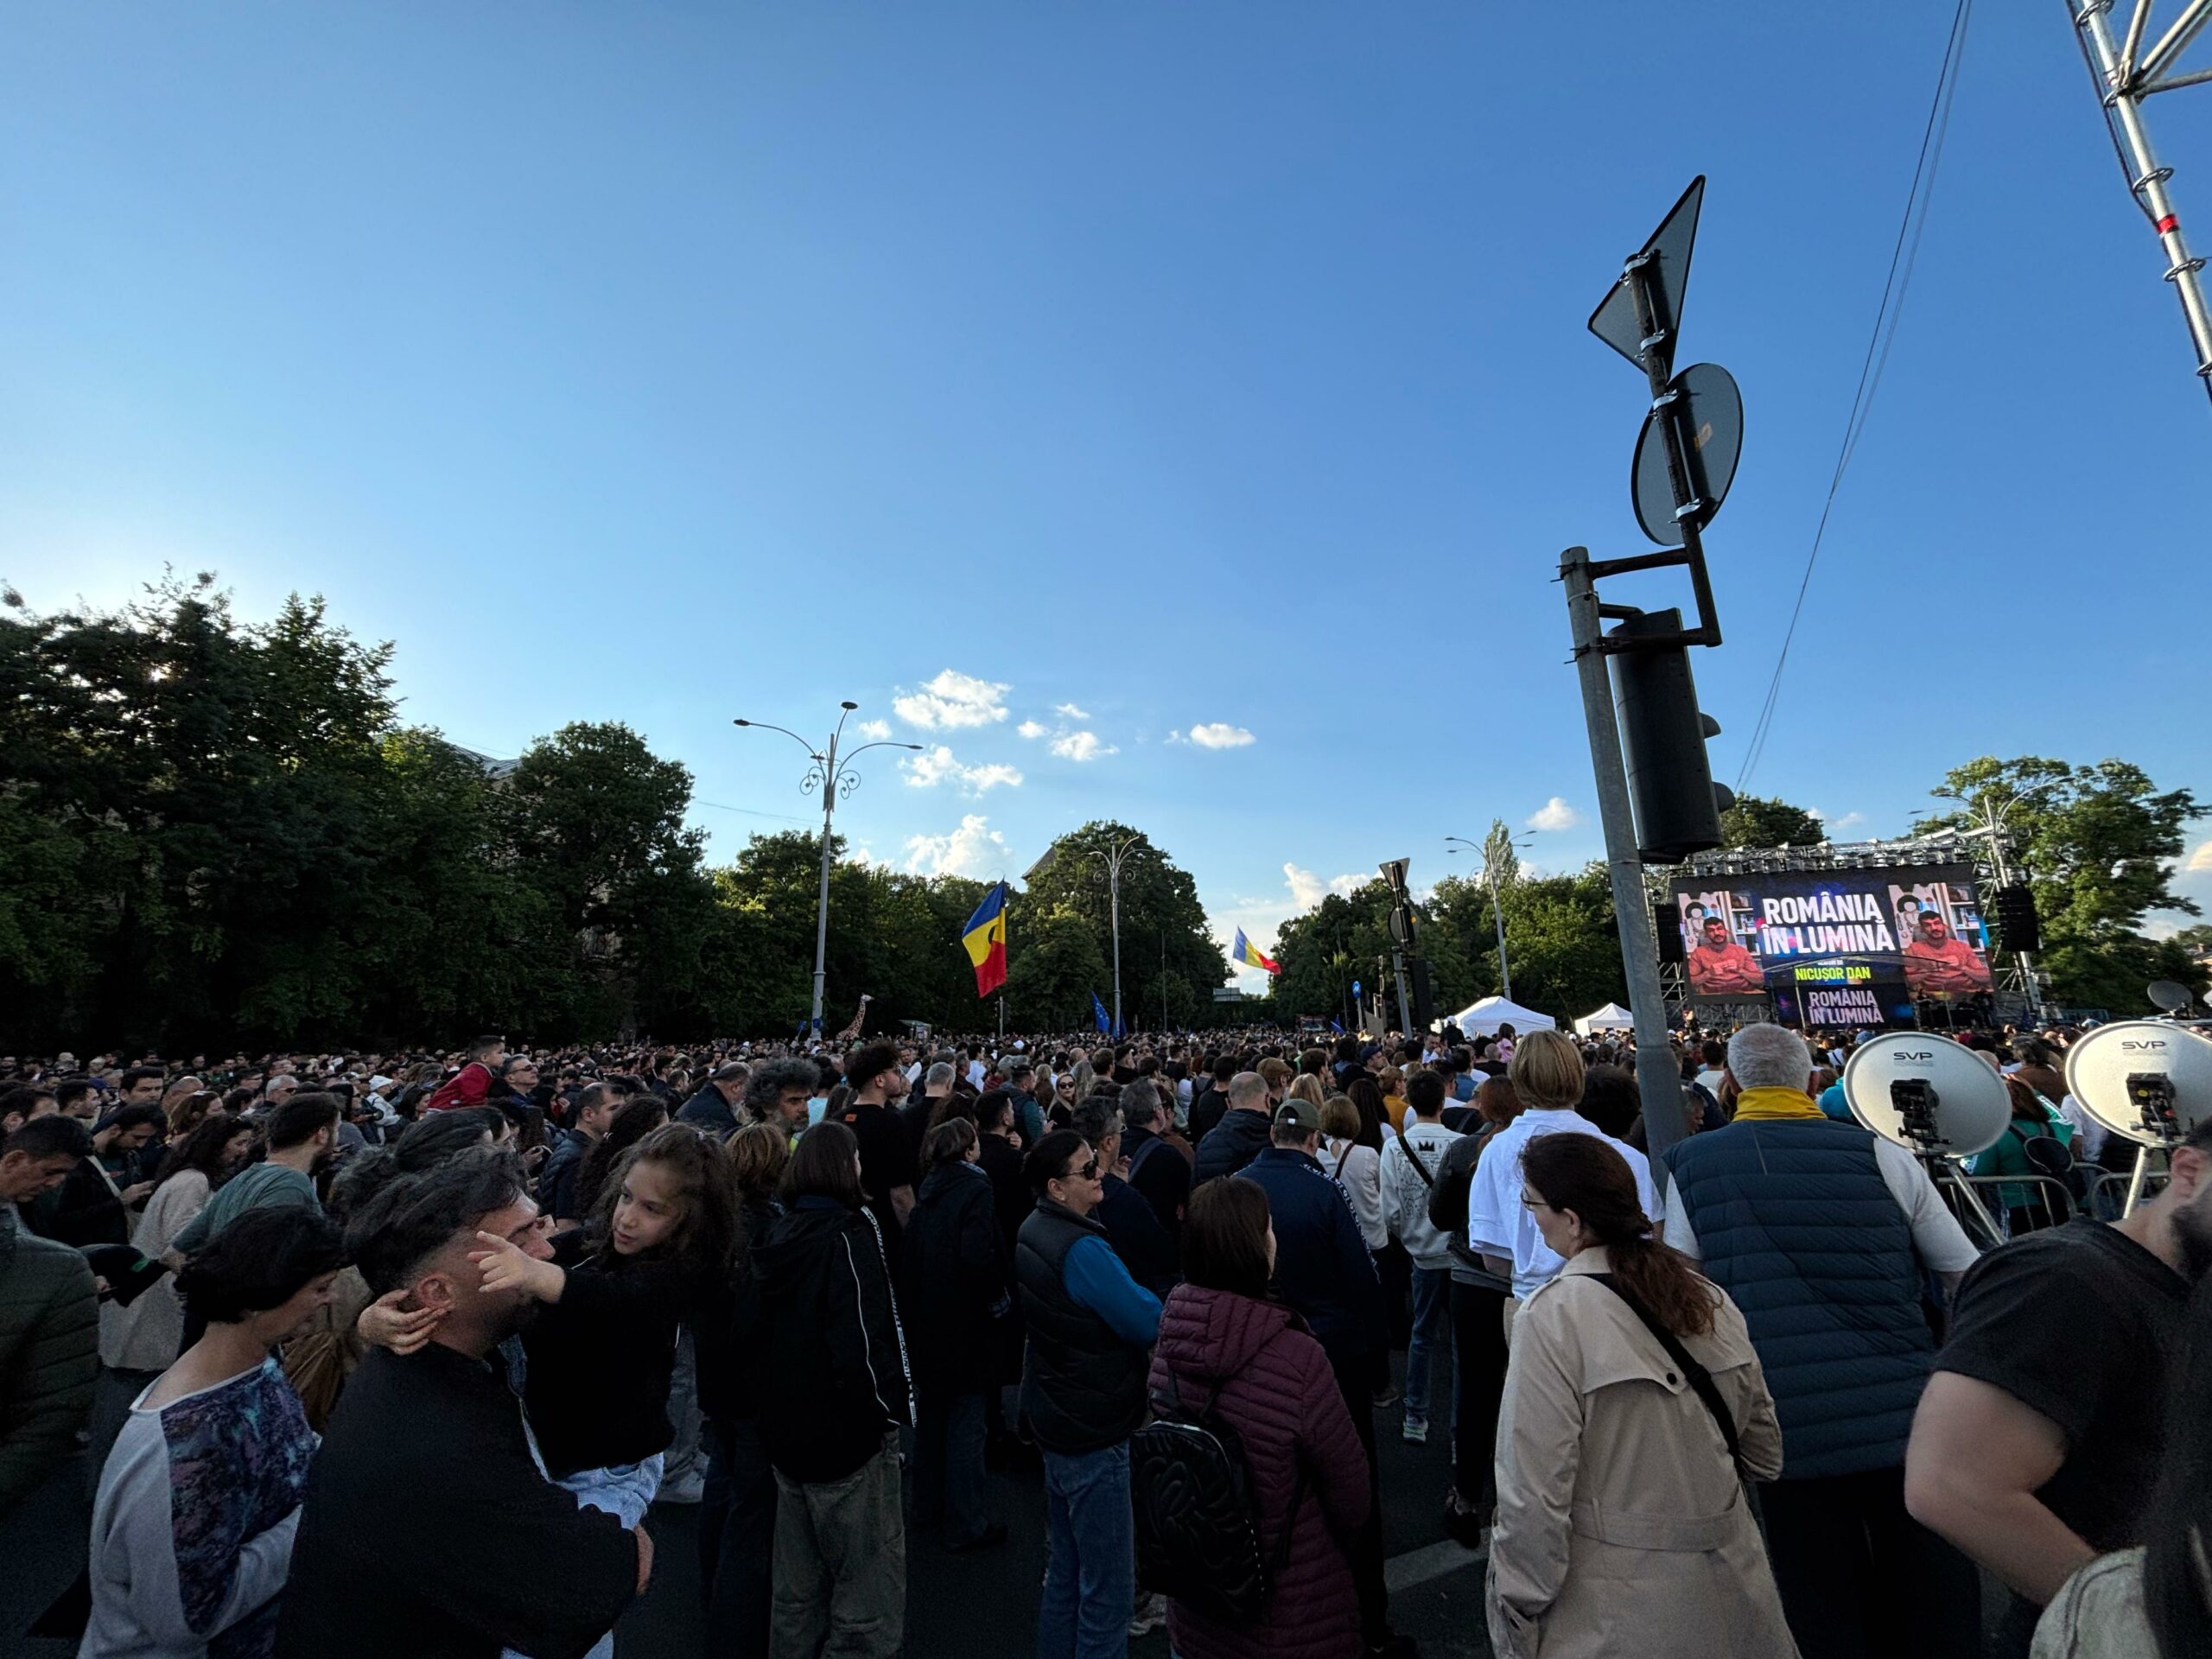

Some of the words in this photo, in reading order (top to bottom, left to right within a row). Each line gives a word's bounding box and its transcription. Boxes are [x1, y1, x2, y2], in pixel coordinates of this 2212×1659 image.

[1762, 891, 1885, 925] ROMÂNIA
[1760, 923, 1790, 955] ÎN
[1794, 919, 1896, 953] LUMINĂ
[1846, 966, 1871, 979] DAN
[1808, 988, 1878, 1007] ROMÂNIA
[1827, 1005, 1885, 1024] LUMINĂ
[2121, 1040, 2166, 1050] SVP
[1893, 1052, 1933, 1060] SVP
